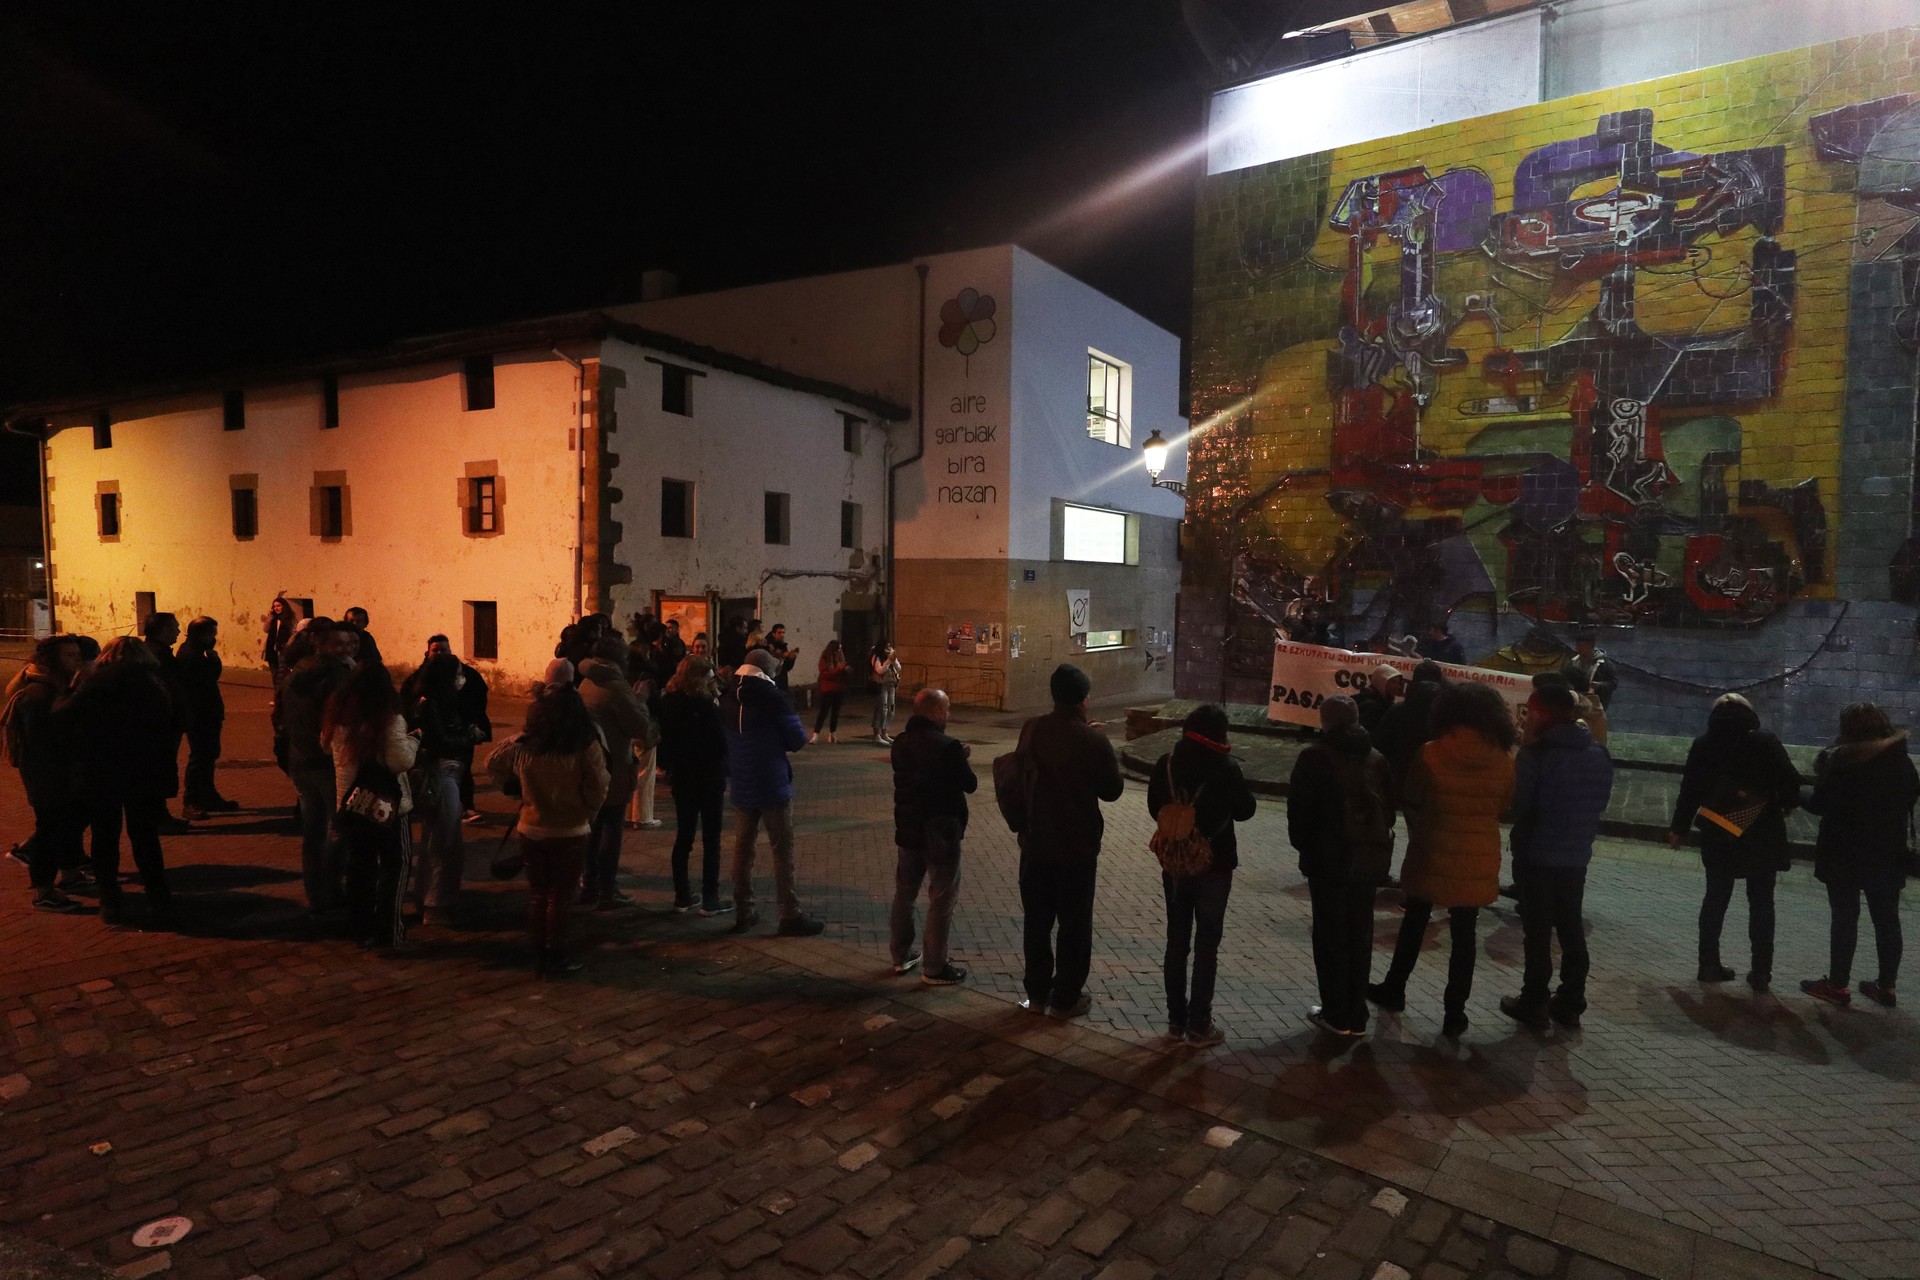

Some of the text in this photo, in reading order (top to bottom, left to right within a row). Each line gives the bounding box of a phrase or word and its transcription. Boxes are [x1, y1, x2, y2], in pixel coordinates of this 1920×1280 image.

[950, 395, 986, 414] aire
[948, 455, 985, 474] bira
[938, 485, 997, 504] nazan
[1277, 644, 1516, 686] EZ EZKUTATU ZUEN KUDEAKE AMALGARRIA
[1334, 669, 1372, 690] CO
[1272, 684, 1325, 710] PASA
